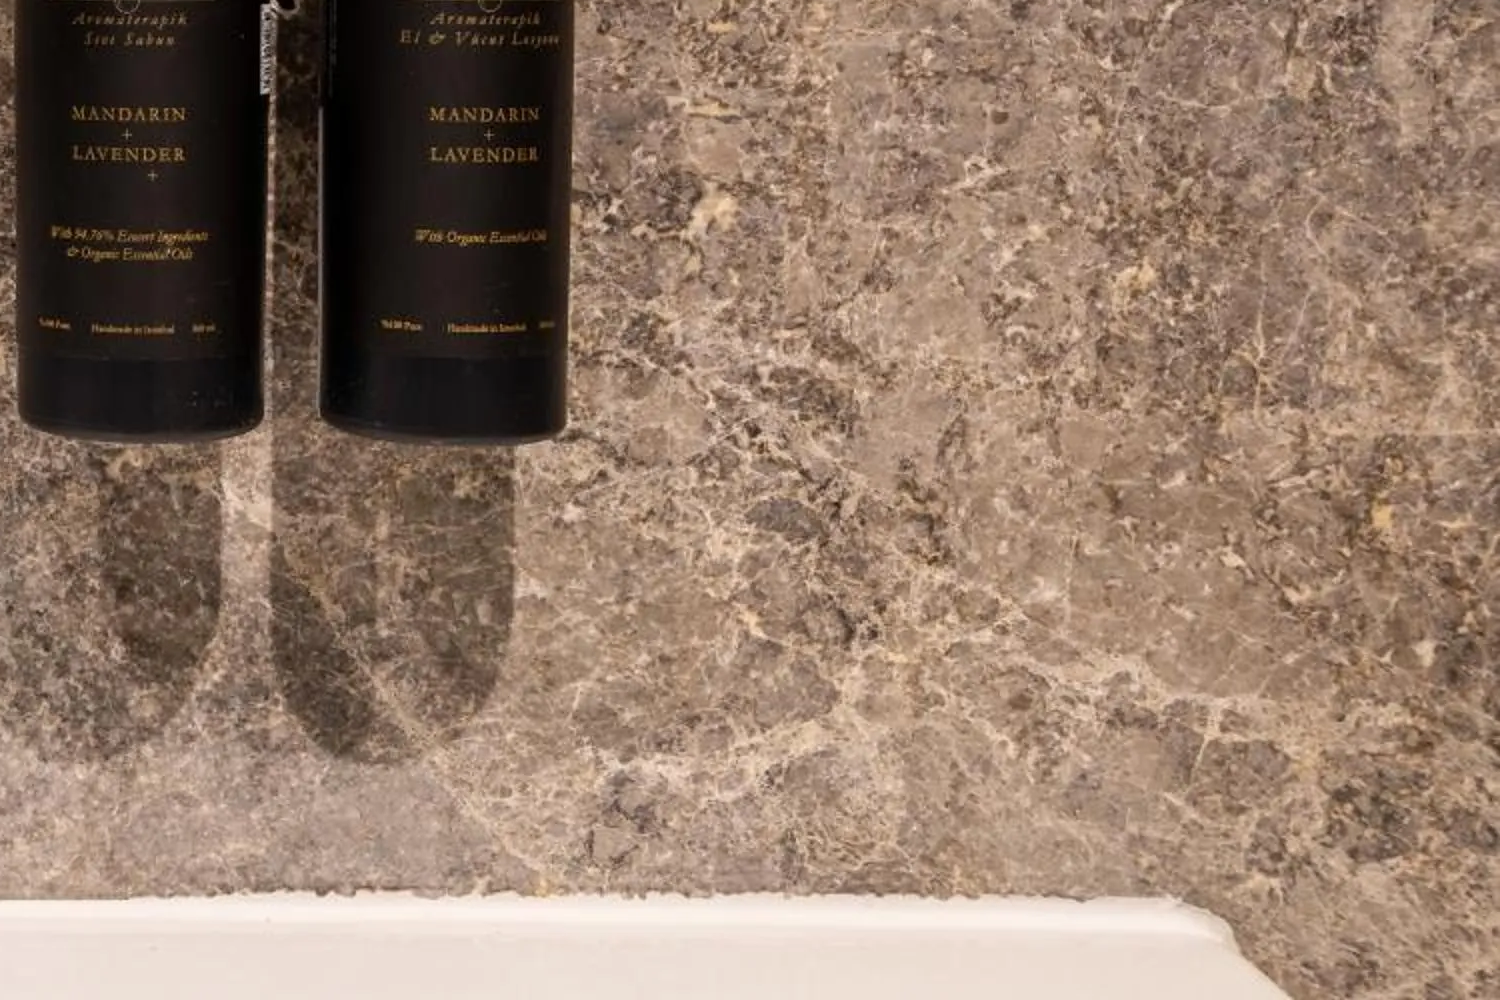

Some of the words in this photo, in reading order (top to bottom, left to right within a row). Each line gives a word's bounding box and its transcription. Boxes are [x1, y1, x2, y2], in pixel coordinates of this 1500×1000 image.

[70, 104, 187, 122] MANDARIN
[429, 107, 540, 122] MANDARIN
[72, 145, 186, 162] LAVENDER
[430, 147, 539, 163] LAVENDER
